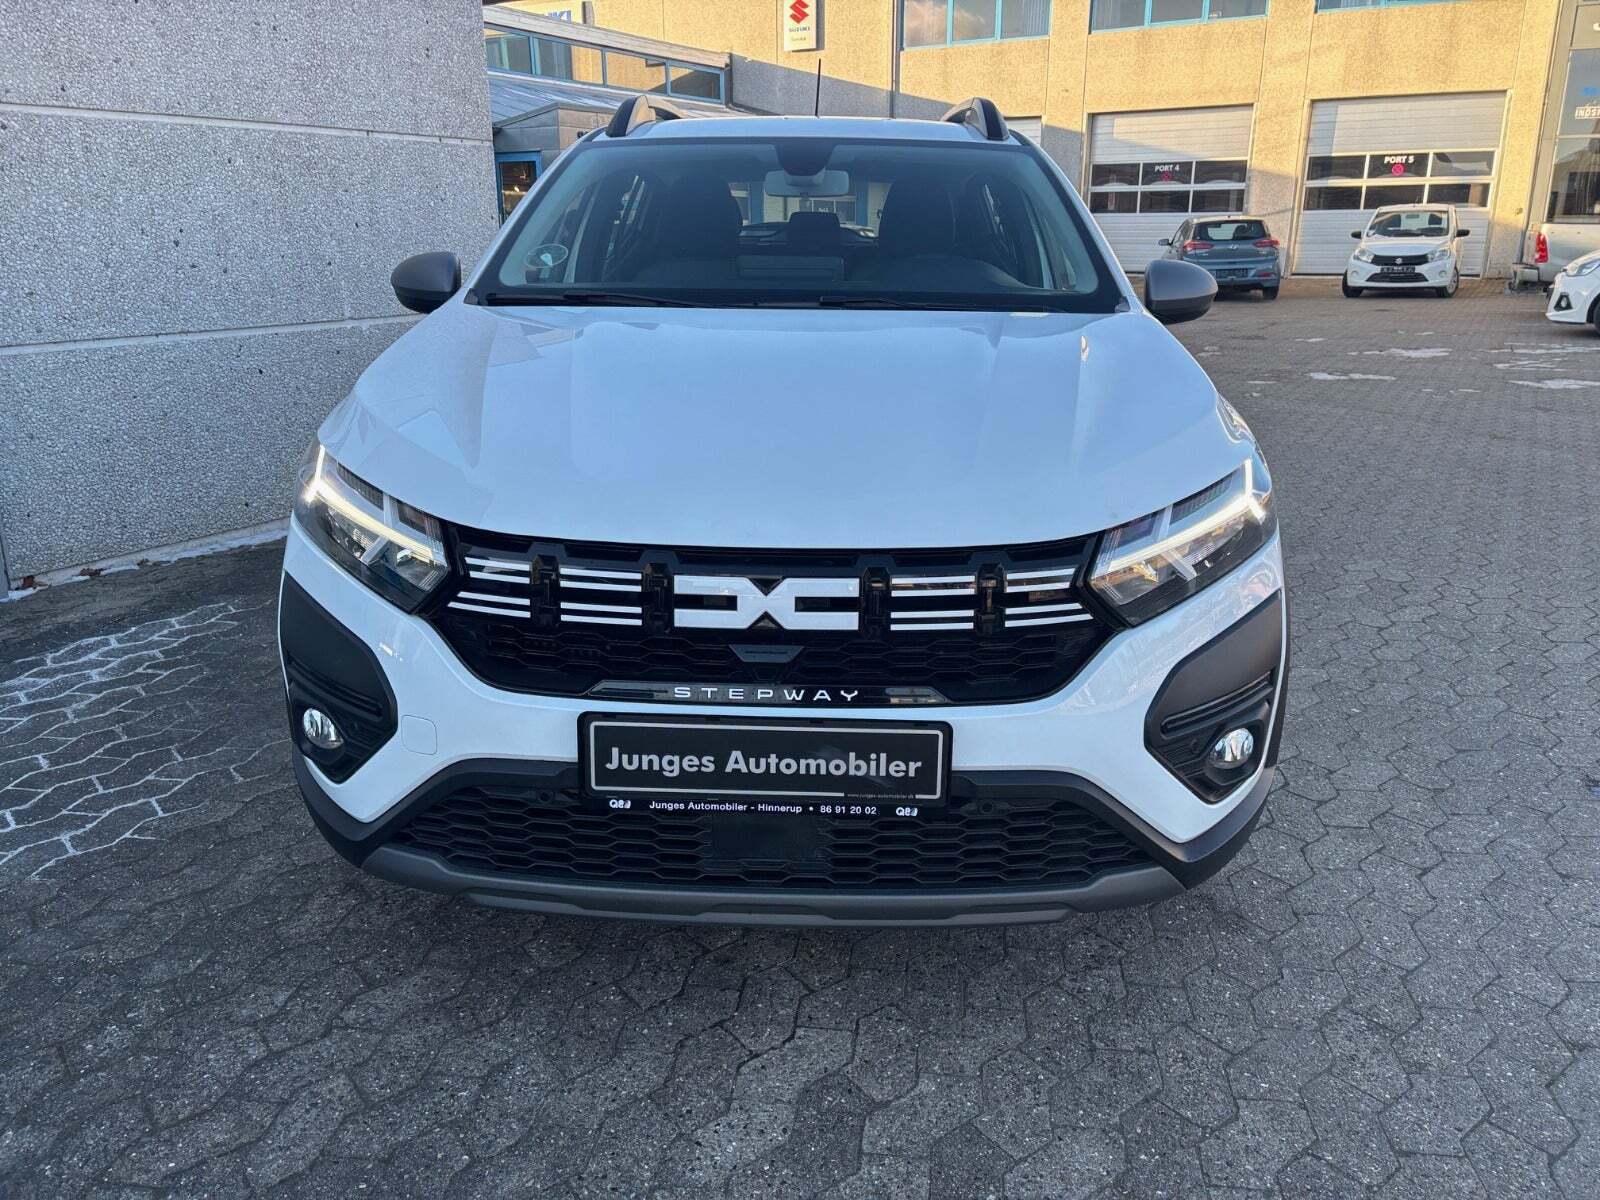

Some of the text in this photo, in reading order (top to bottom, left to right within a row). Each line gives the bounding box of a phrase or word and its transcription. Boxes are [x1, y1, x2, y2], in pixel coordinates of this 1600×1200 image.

[1383, 155, 1415, 164] PORT 5
[673, 687, 859, 701] STEPWAY
[605, 747, 922, 777] Junges Automobiler
[649, 801, 685, 811] Junges
[687, 802, 748, 811] Automobiler
[757, 803, 803, 813] Hinnerup
[820, 805, 832, 814] 86
[835, 805, 846, 814] 91
[849, 806, 862, 814] 20
[864, 806, 877, 815] 02
